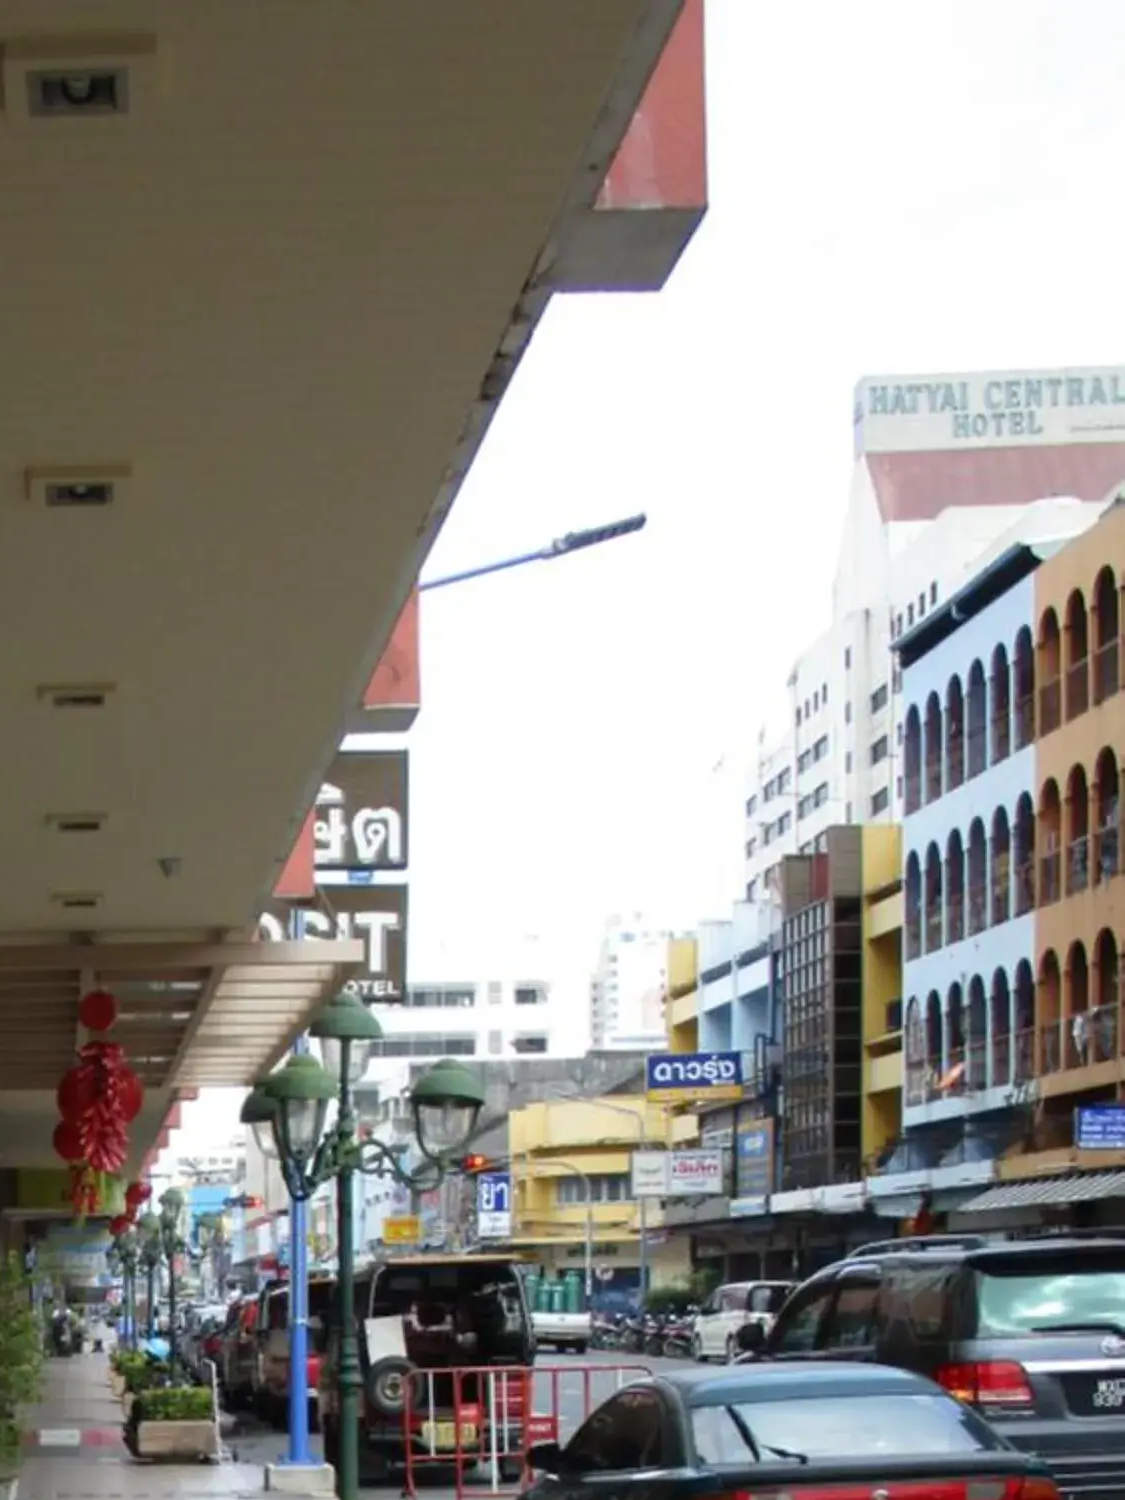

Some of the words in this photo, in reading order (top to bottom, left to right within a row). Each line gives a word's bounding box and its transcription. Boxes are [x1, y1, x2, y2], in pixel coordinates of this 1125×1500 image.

[869, 382, 969, 415] HATYAI
[983, 374, 1125, 409] CENTRAL
[952, 411, 1043, 438] HOTEL
